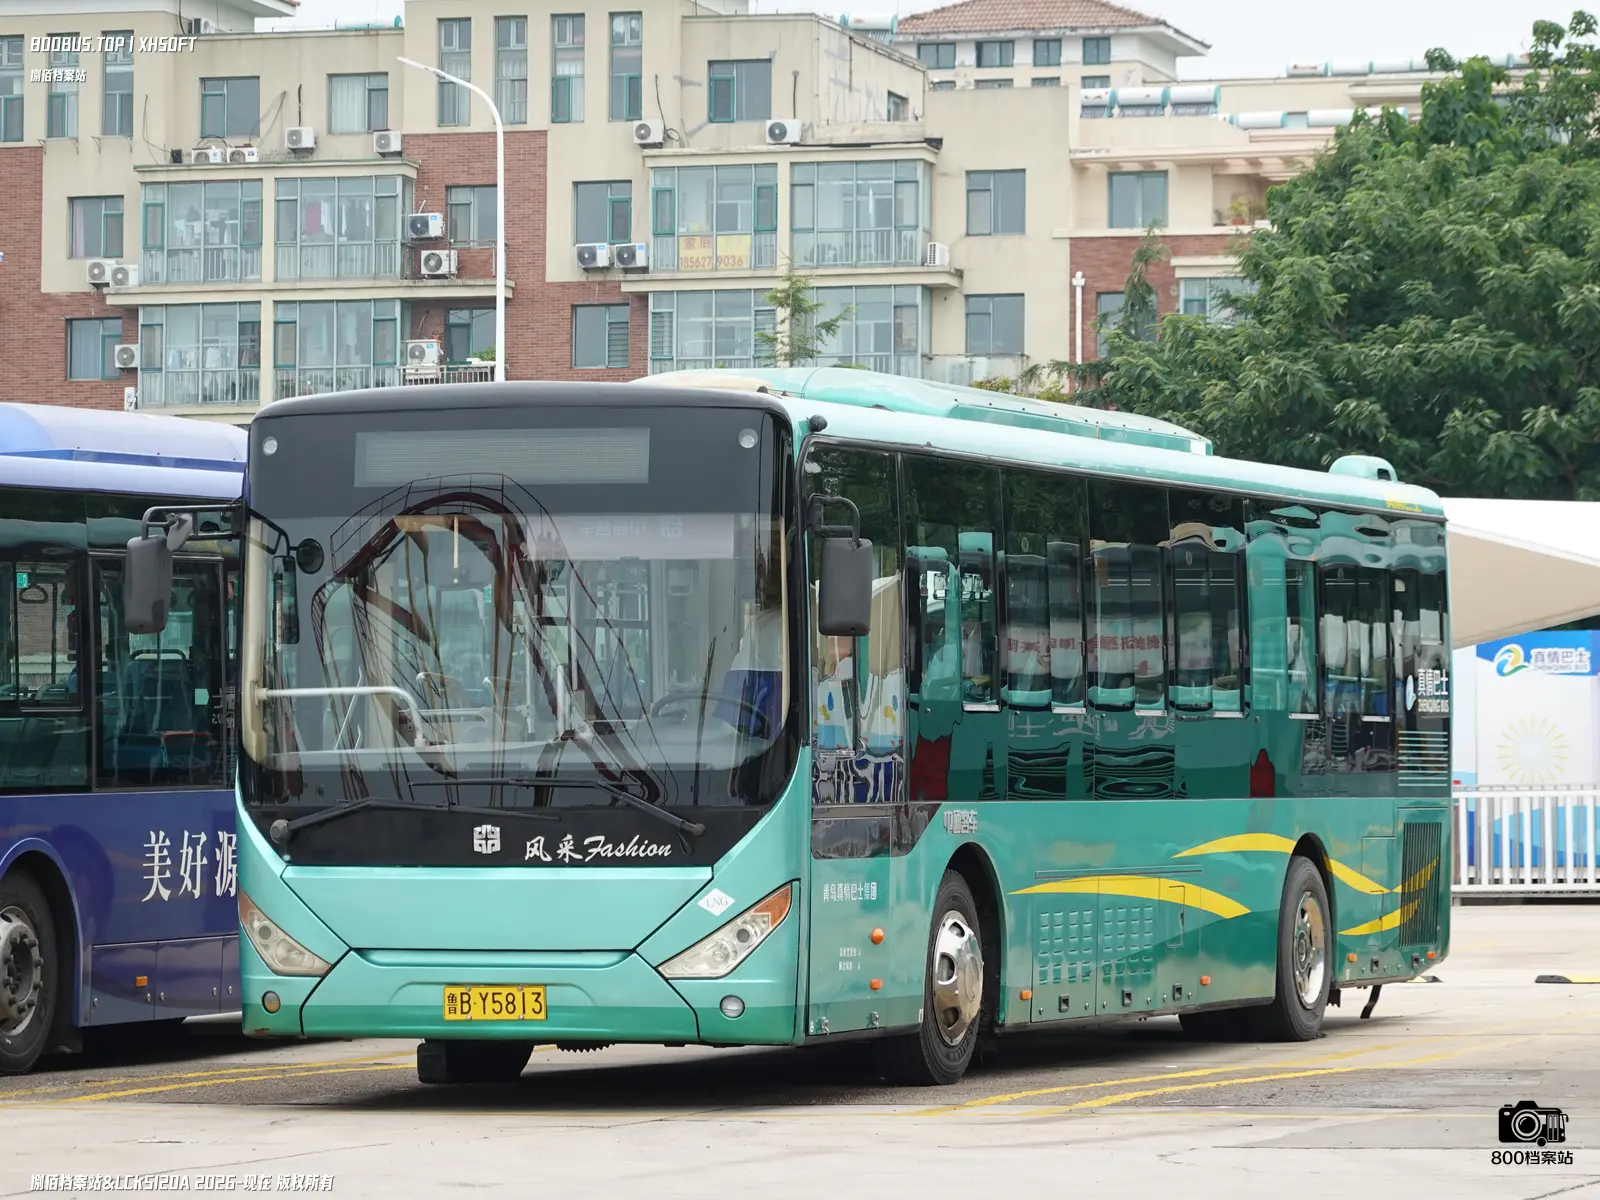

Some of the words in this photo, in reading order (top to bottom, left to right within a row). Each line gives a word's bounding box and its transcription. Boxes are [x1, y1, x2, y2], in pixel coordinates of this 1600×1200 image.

[1533, 649, 1588, 664] 真情巴士
[1417, 668, 1449, 696] 真情巴士
[584, 834, 672, 863] Fashion
[141, 830, 238, 902] 美好源
[706, 895, 729, 909] LNG
